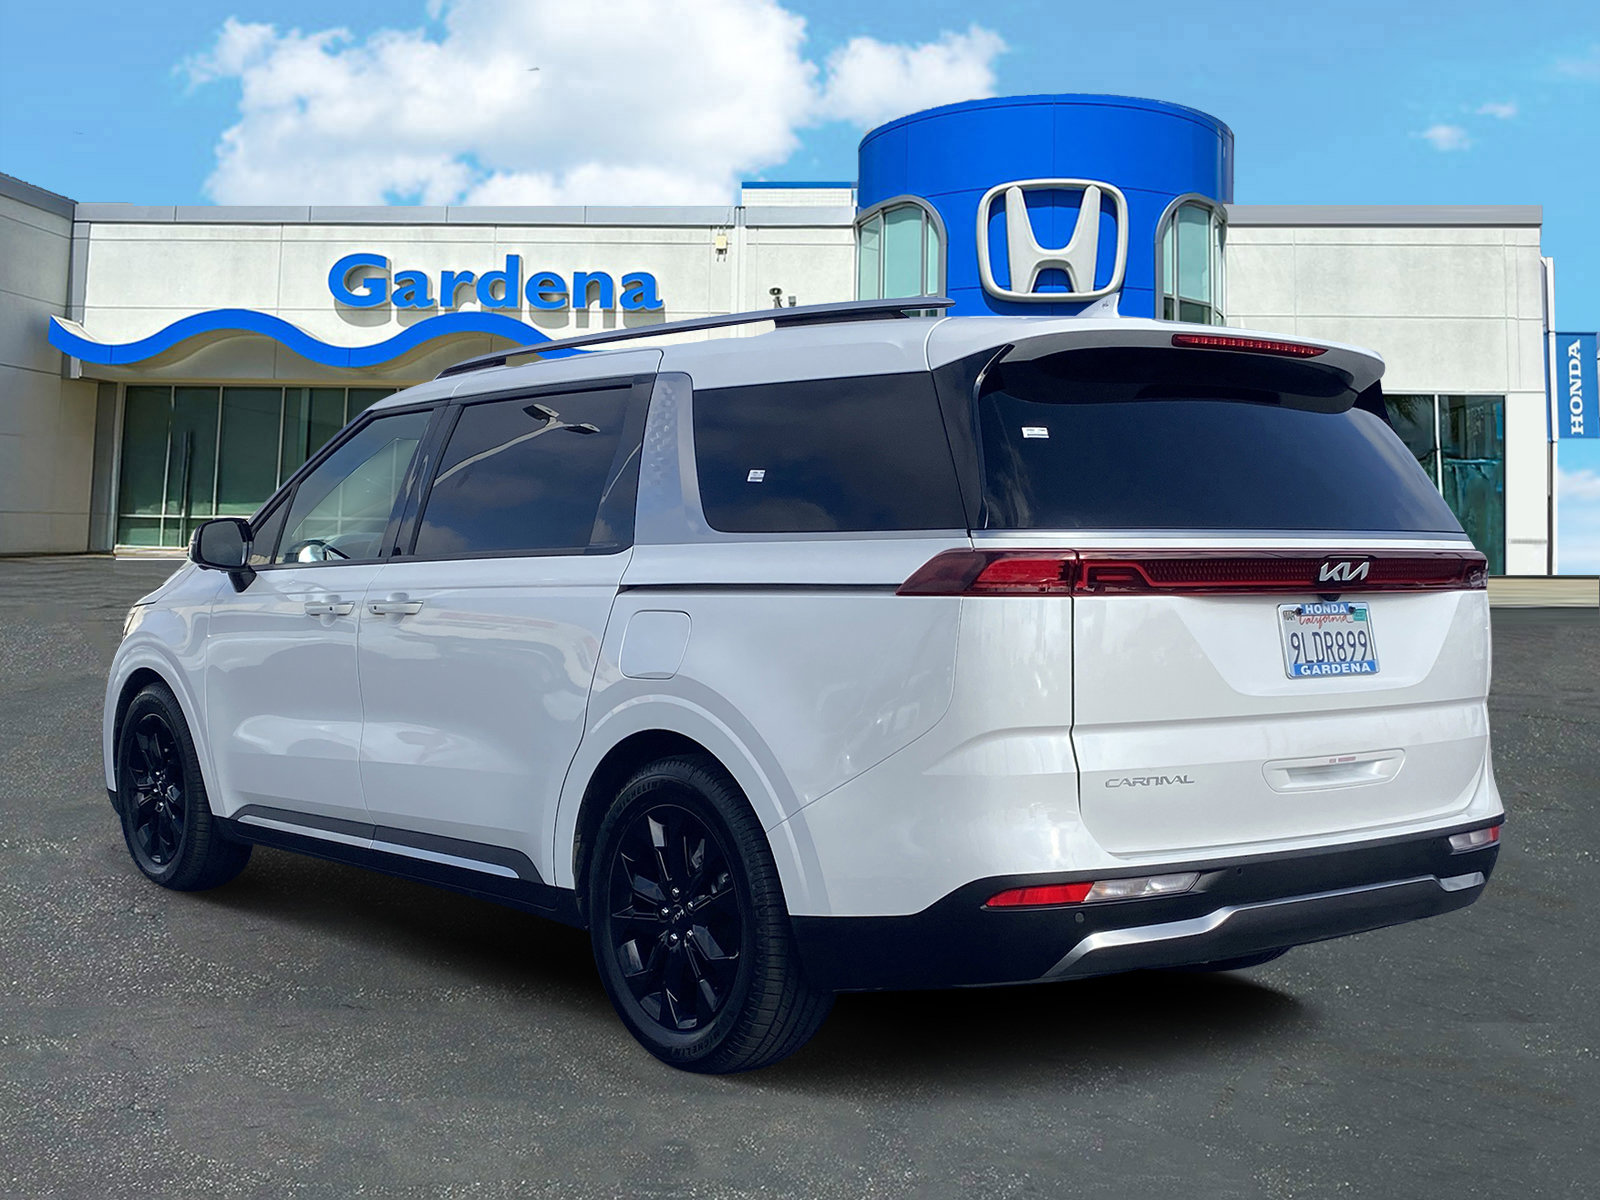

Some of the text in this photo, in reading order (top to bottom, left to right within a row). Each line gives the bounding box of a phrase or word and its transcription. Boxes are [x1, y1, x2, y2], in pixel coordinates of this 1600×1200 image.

[328, 253, 663, 310] Gardena
[1568, 339, 1584, 435] HONDA
[1319, 562, 1370, 581] KIA
[1305, 604, 1347, 614] HONDA
[1299, 614, 1354, 629] California
[1290, 630, 1367, 664] 9LDR899
[1300, 663, 1371, 675] GARDENA
[1105, 775, 1195, 788] CARNIVAL
